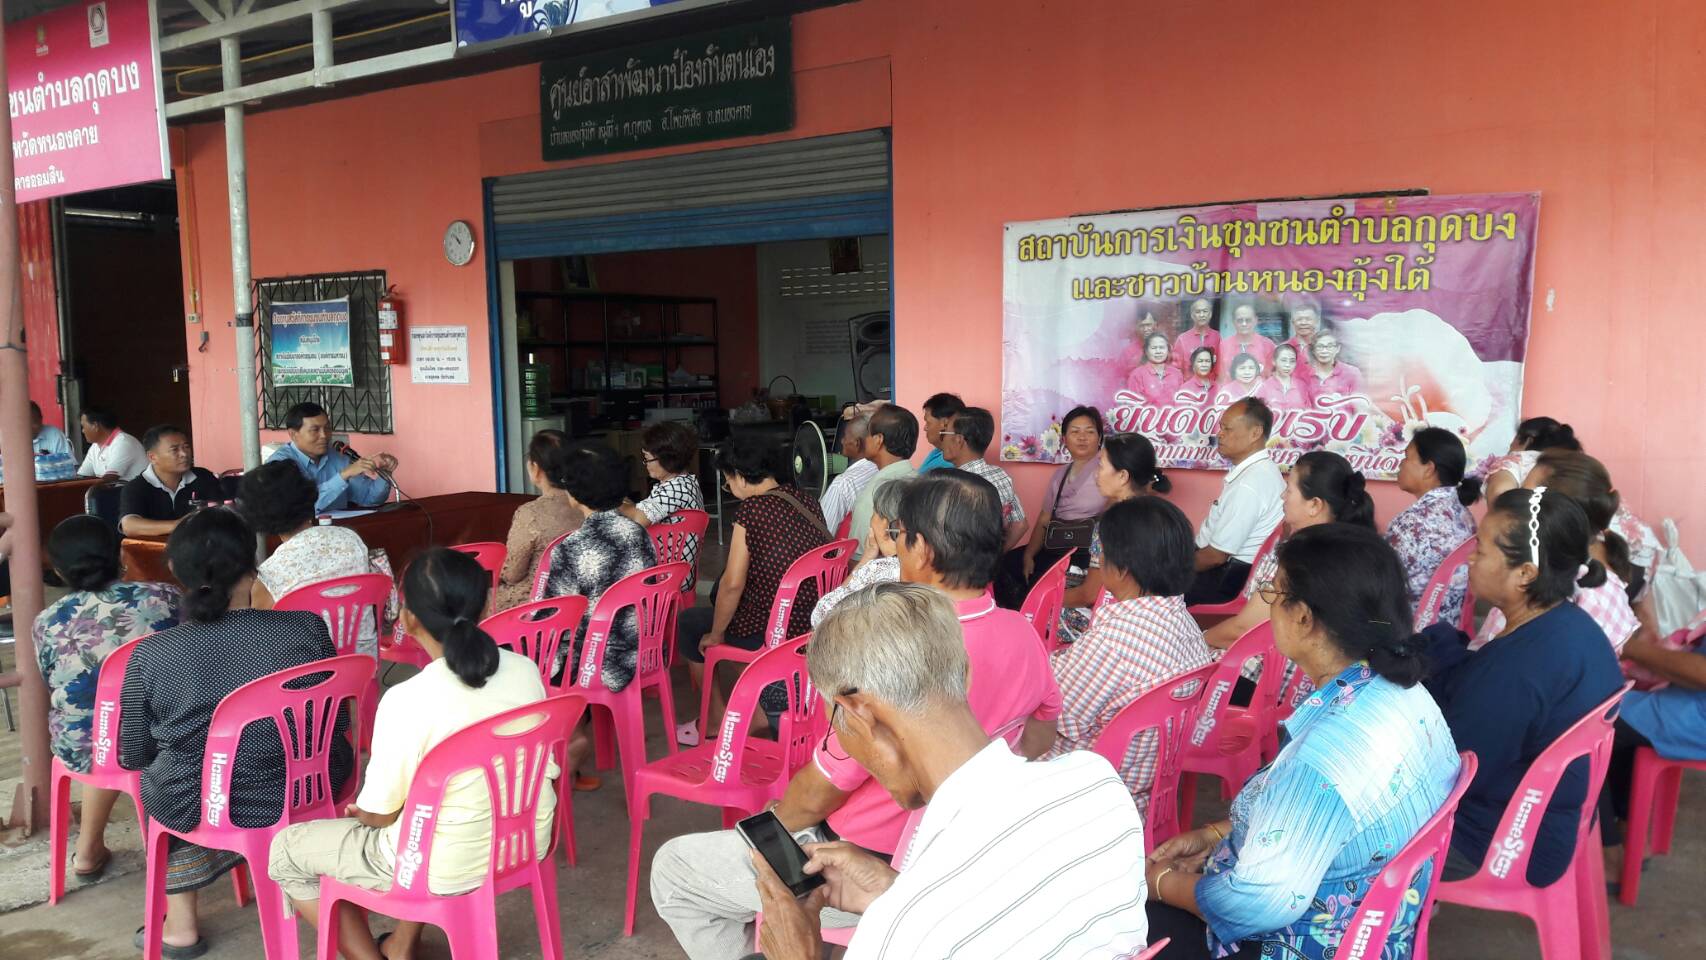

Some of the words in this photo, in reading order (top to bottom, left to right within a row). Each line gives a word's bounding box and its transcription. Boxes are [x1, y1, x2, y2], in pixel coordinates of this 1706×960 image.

[1018, 206, 1517, 262] สถาบันการเงินชุมชนตำบลกุดบง
[1072, 254, 1435, 302] และชาวบ้านหนองกุ้งใต้
[1113, 390, 1370, 442] ยินดีต้นรับ
[94, 700, 115, 766] HomeStay
[713, 711, 741, 783] HomeStay
[1191, 680, 1232, 748] HomeStay
[206, 752, 228, 827] HomeStay
[397, 803, 433, 890] HomeStay
[1489, 788, 1544, 879] HomeStay
